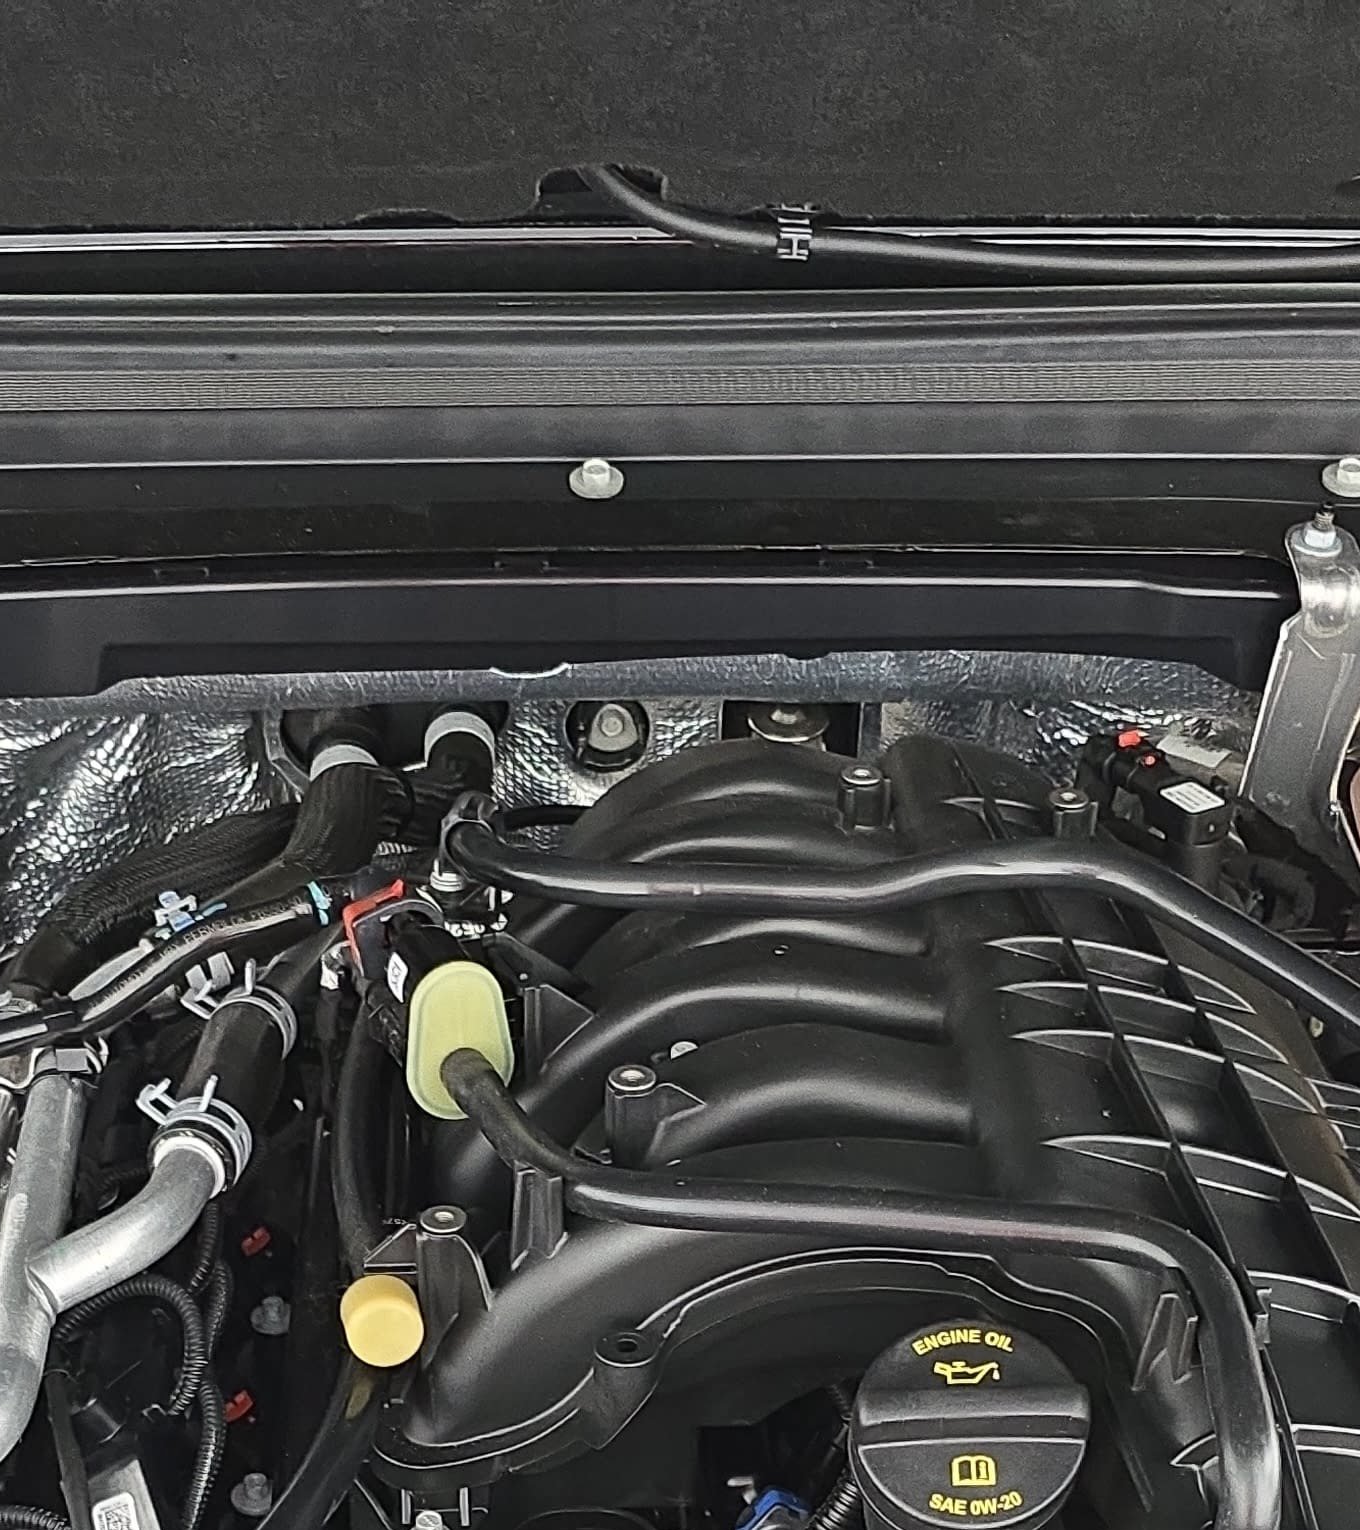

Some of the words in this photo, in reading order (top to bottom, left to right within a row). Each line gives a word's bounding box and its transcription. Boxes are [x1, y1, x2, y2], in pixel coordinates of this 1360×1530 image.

[911, 1328, 981, 1356] ENGINE
[983, 1331, 1015, 1352] OIL
[929, 1493, 967, 1515] SAE
[969, 1491, 1023, 1515] 0W-20
